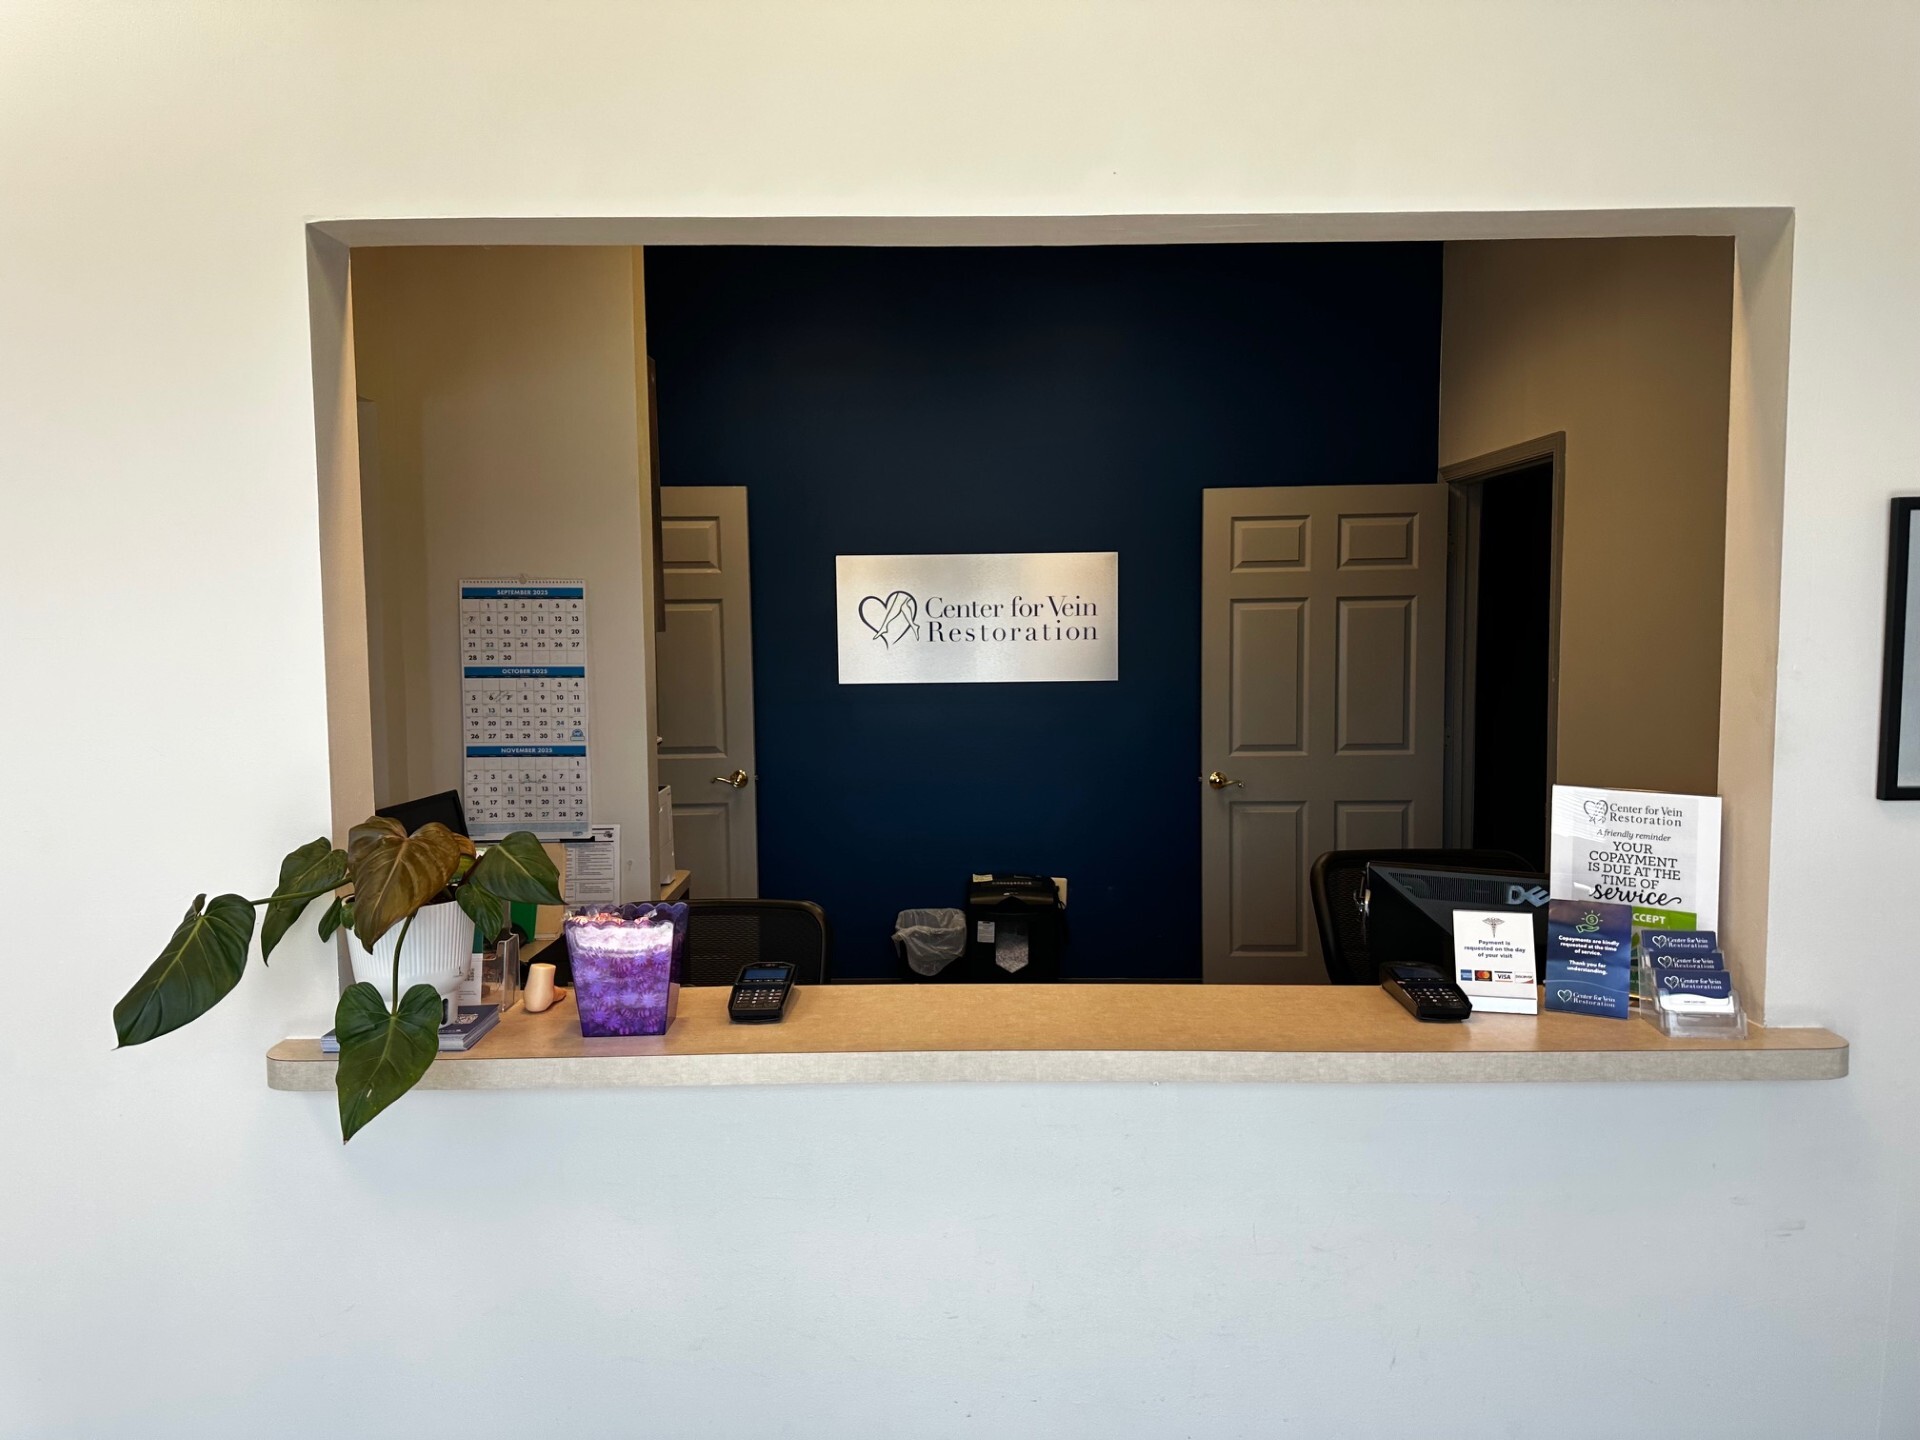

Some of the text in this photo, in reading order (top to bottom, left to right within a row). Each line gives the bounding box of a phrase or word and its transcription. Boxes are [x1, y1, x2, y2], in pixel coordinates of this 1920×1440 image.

[925, 595, 1099, 619] Center for Vein
[926, 619, 1099, 643] Restoration
[1609, 802, 1683, 818] Center for Vein
[1609, 812, 1682, 827] Restoration
[1597, 828, 1672, 842] A friendly reminder
[1613, 841, 1653, 855] YOUR
[1589, 850, 1678, 869] COPAYMENT
[1588, 861, 1681, 881] IS DUE AT THE
[1601, 874, 1659, 890] TIME OF
[1507, 885, 1551, 908] DE
[1588, 883, 1682, 906] service
[1632, 913, 1666, 925] CCEPT
[1558, 935, 1592, 944] Copayments
[1602, 939, 1620, 947] kindly
[1573, 992, 1593, 1000] Center
[1573, 997, 1616, 1008] Restoration
